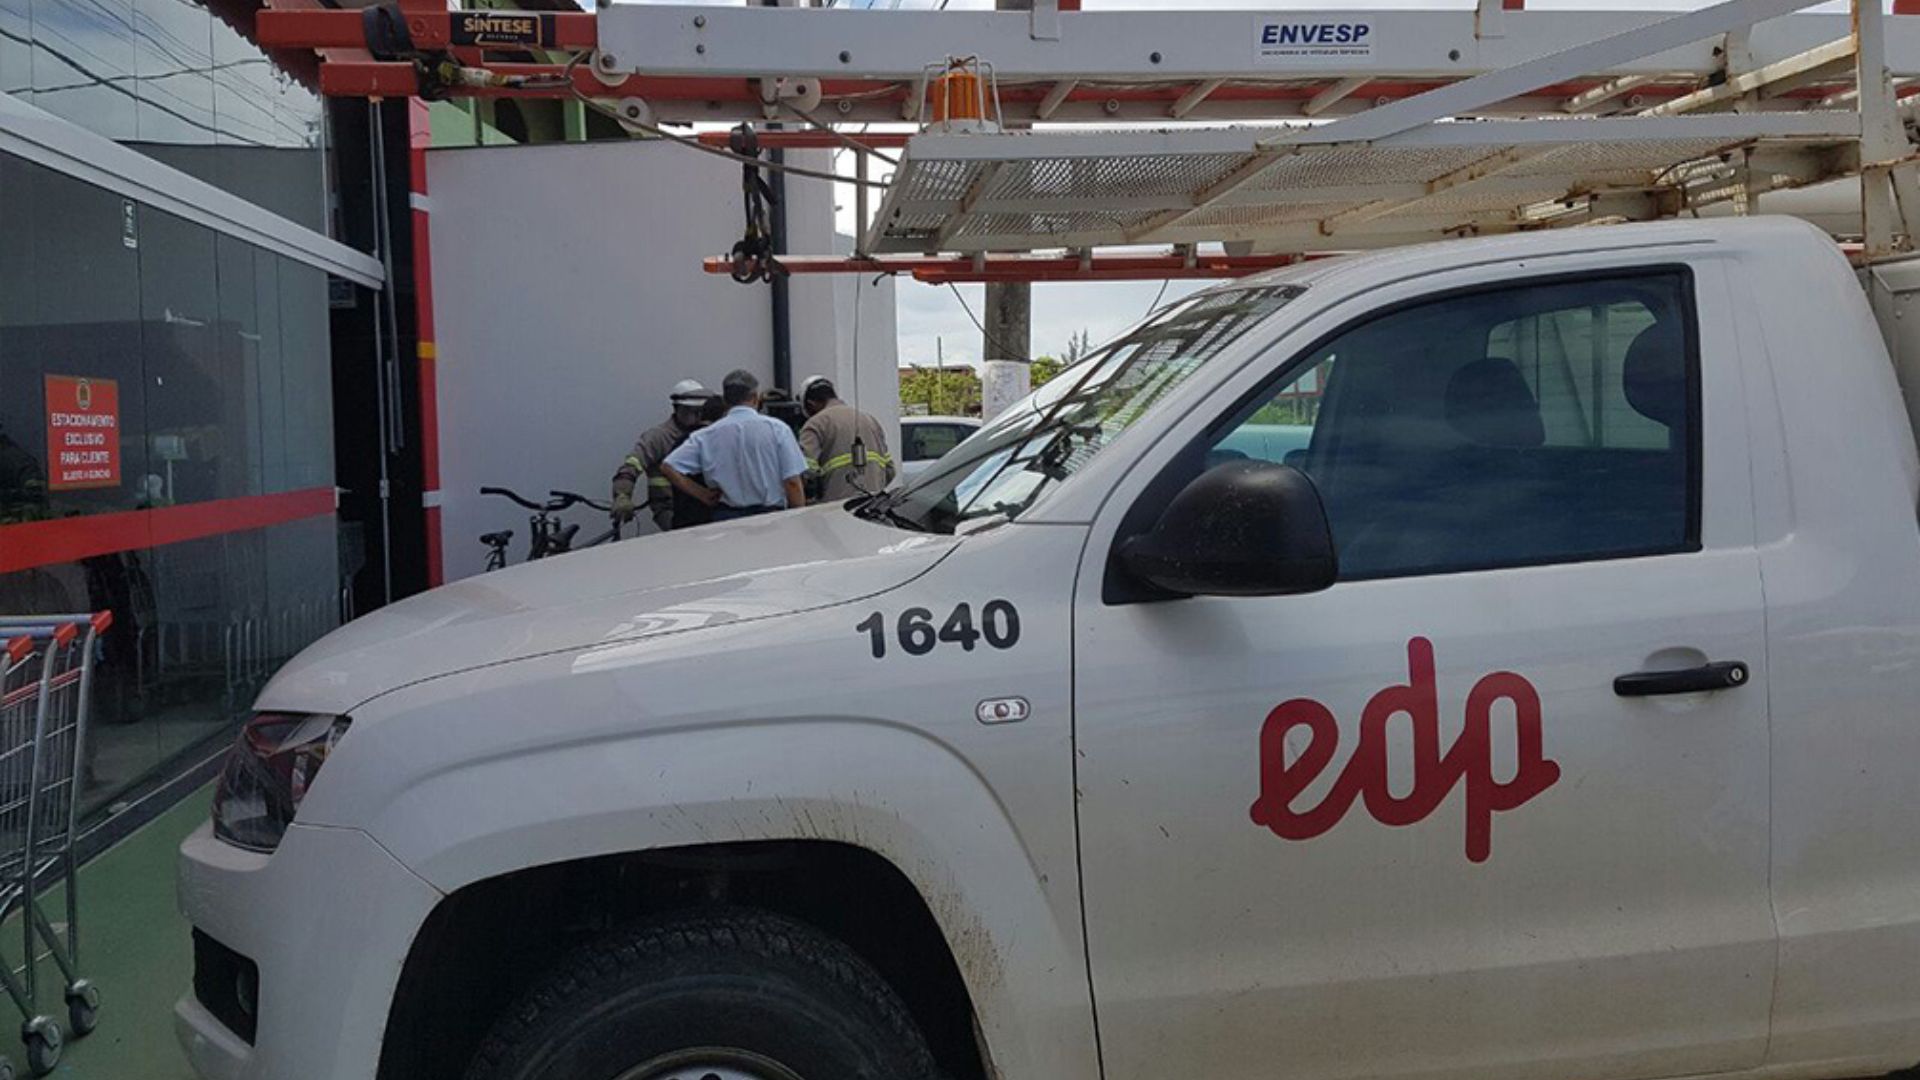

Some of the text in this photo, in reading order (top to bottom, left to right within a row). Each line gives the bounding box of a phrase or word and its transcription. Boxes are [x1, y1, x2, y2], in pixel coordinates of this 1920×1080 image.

[1261, 24, 1370, 44] ENVESP
[51, 413, 115, 427] ESTACIONAMENTO
[64, 432, 105, 446] EXCLUSIVO
[60, 451, 110, 465] PARA CLIENTE
[856, 599, 1020, 659] 1640
[1250, 636, 1560, 863] edp
